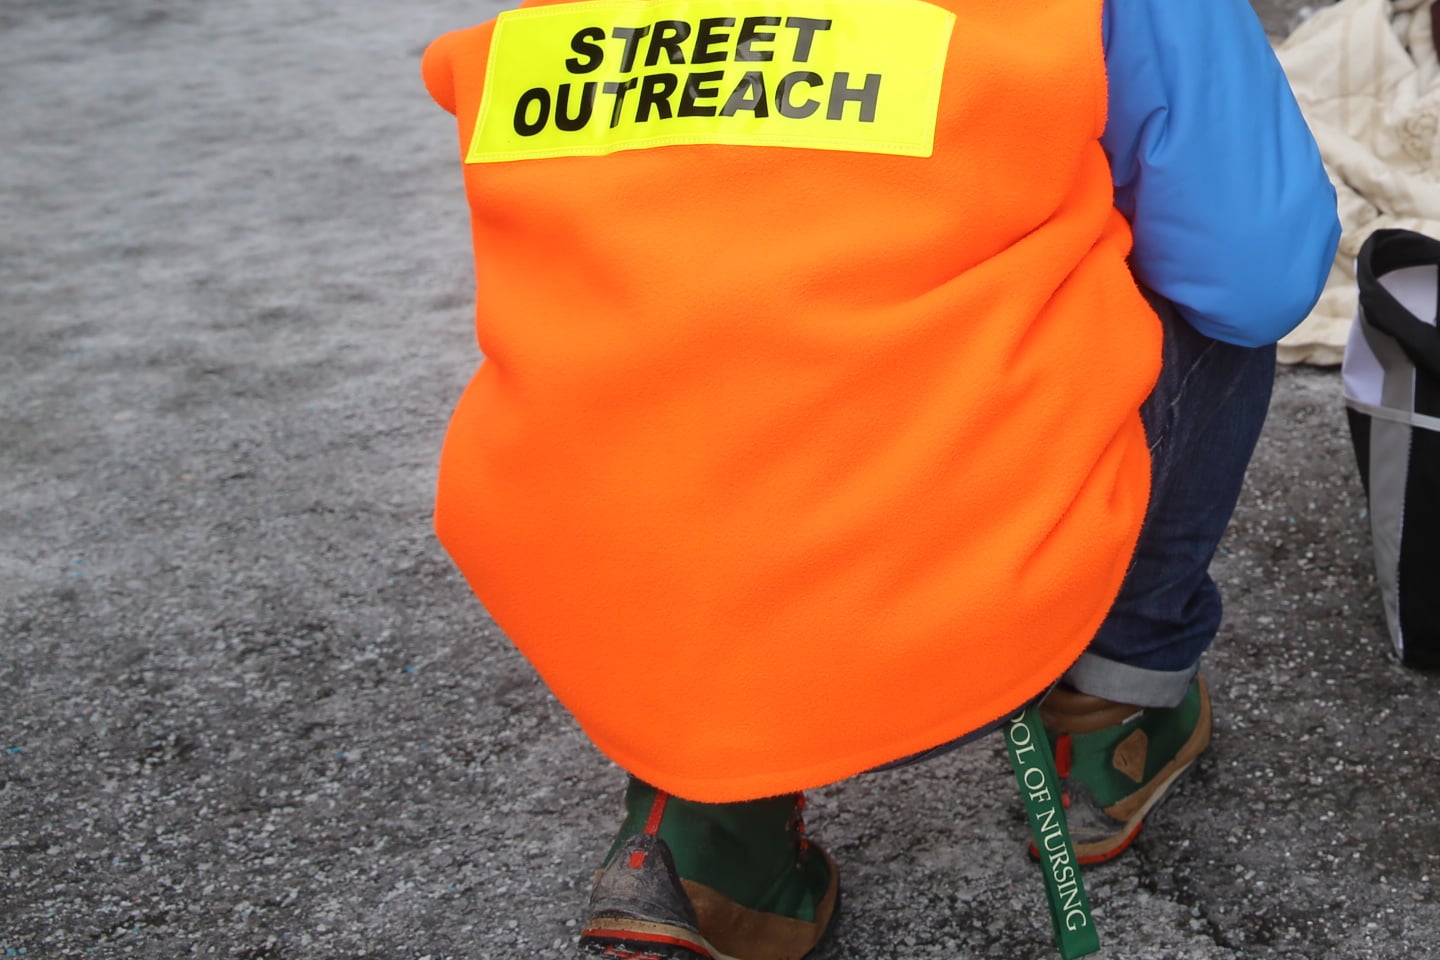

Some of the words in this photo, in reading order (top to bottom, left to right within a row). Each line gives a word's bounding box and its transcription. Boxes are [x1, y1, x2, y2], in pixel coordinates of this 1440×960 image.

[564, 16, 832, 74] STREET
[512, 71, 882, 137] OUTREACH
[1024, 767, 1052, 803] OF
[1036, 807, 1087, 932] NURSING
